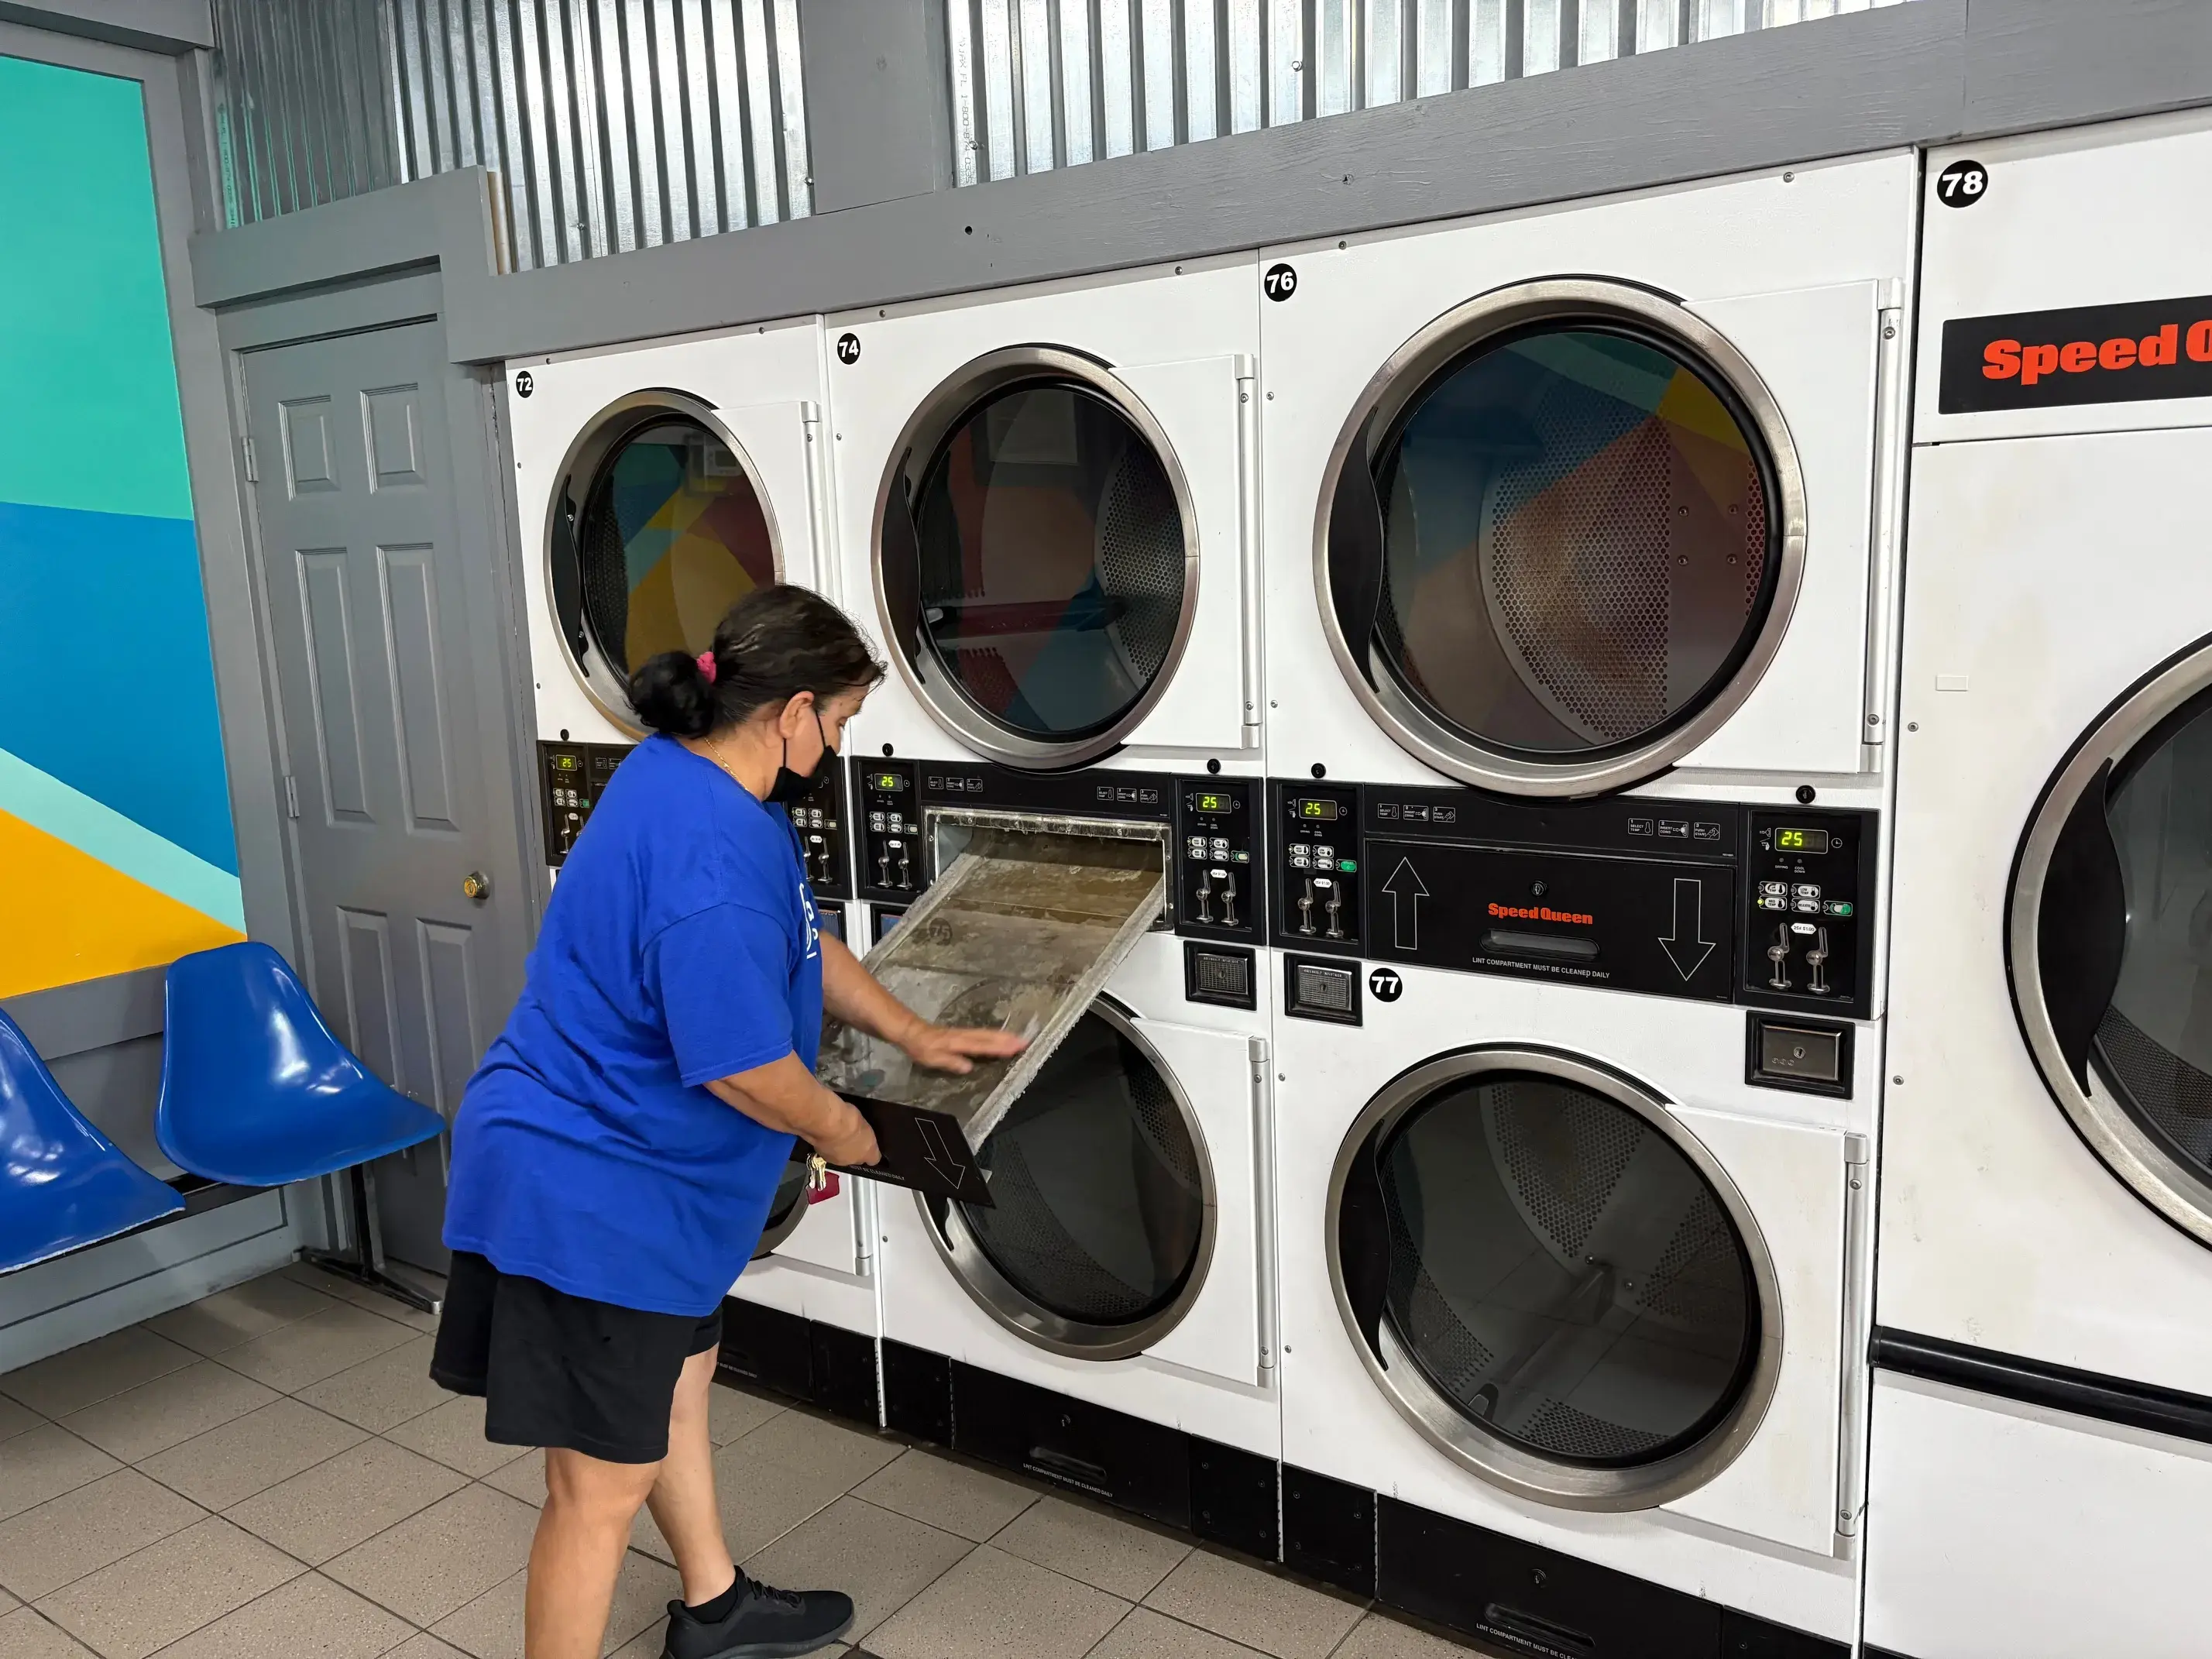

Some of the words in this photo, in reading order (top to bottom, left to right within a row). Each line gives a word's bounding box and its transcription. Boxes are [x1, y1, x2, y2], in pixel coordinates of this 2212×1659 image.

[1942, 170, 1984, 198] 78
[1266, 271, 1294, 294] 76
[839, 339, 859, 358] 74
[1982, 323, 2179, 386] Speed
[517, 377, 533, 392] 72
[562, 757, 572, 768] 25
[881, 776, 894, 787] 25
[1202, 796, 1218, 809] 25
[1305, 802, 1321, 815] 25
[1781, 831, 1803, 847] 25
[1488, 902, 1539, 919] Speed
[1540, 907, 1593, 925] Queen
[1486, 958, 1532, 970] COMPARTMENT
[1561, 967, 1591, 977] CLEANED
[1372, 976, 1399, 994] 77
[1032, 1465, 1063, 1480] COMPARTMENT
[1063, 1476, 1074, 1485] MUST
[1081, 1482, 1101, 1494] CLEANED
[1101, 1489, 1113, 1498] DAILY
[1475, 1623, 1489, 1633] LINT
[1489, 1627, 1533, 1647] COMPARTMENT
[1533, 1643, 1550, 1654] MUST
[1550, 1649, 1558, 1657] BE
